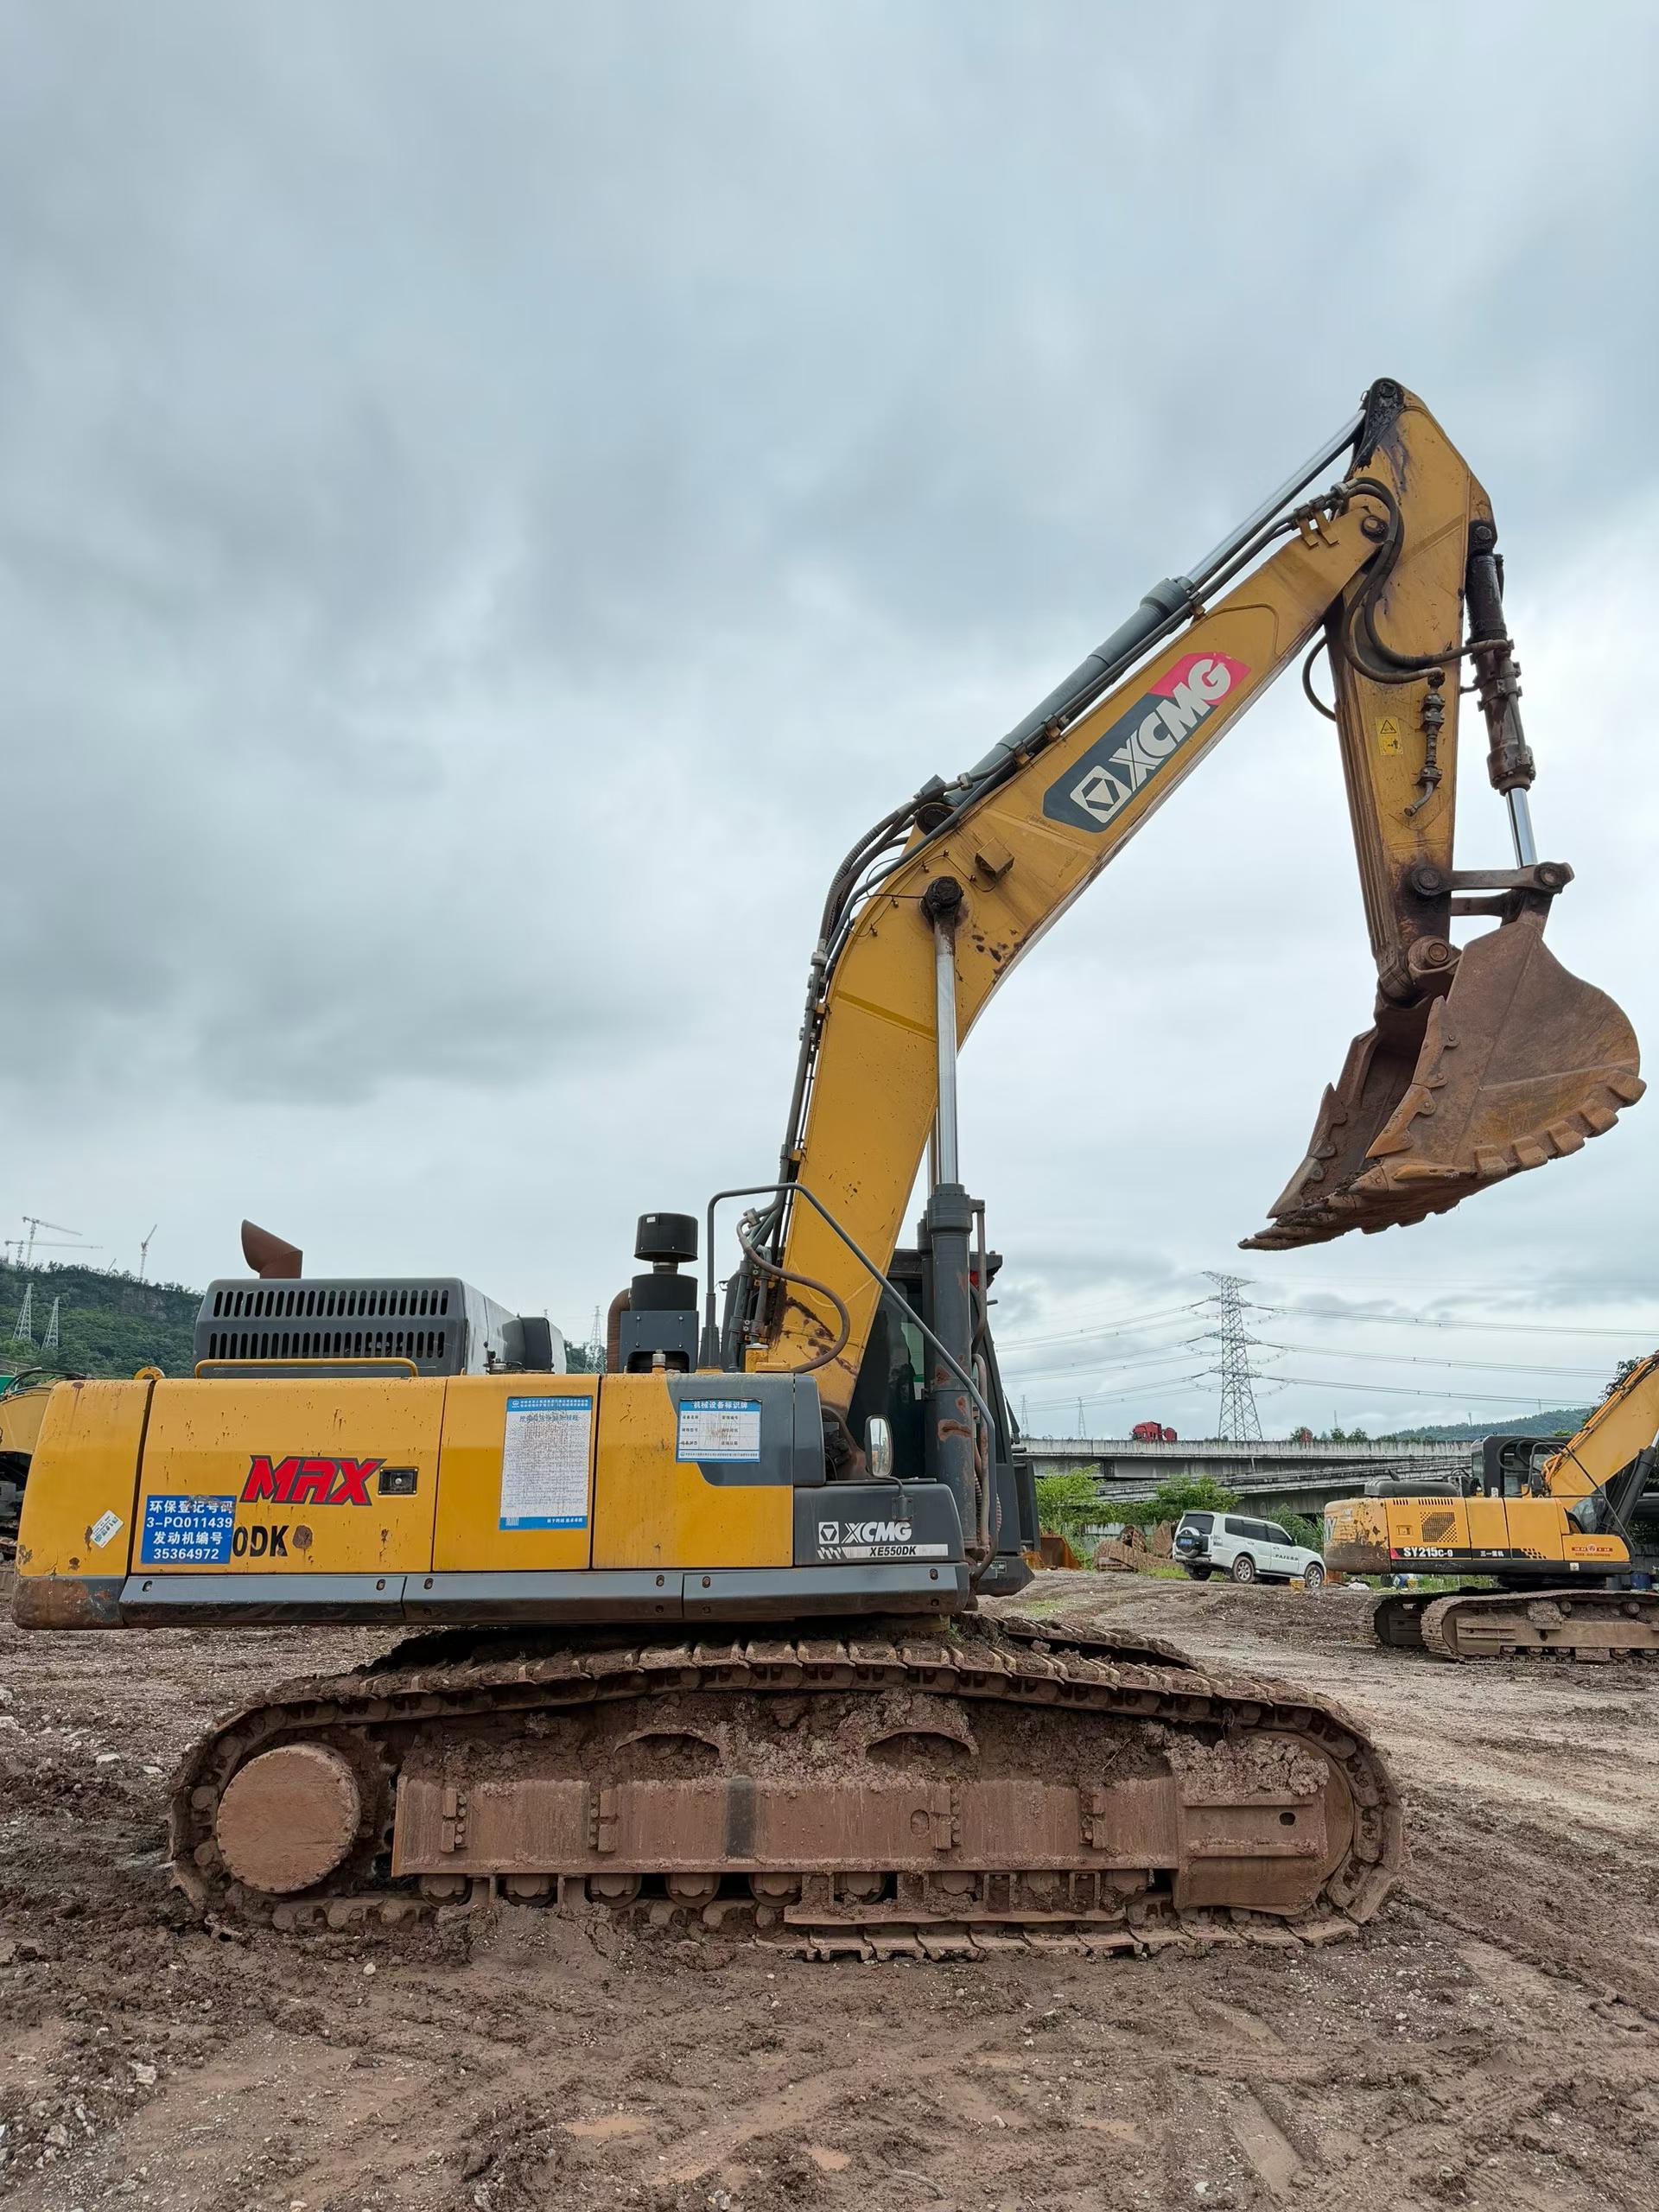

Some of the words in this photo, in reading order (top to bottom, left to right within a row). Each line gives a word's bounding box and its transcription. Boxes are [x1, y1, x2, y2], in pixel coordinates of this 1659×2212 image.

[1108, 658, 1231, 792] XCMG
[239, 1455, 387, 1506] MAX
[149, 1499, 233, 1514] 环保登记号码
[146, 1516, 232, 1529] 3-PQ011439
[153, 1531, 223, 1545] 发动机编号
[842, 1522, 912, 1542] XCMG
[153, 1548, 219, 1560] 35364972
[869, 1546, 917, 1556] XE550DK
